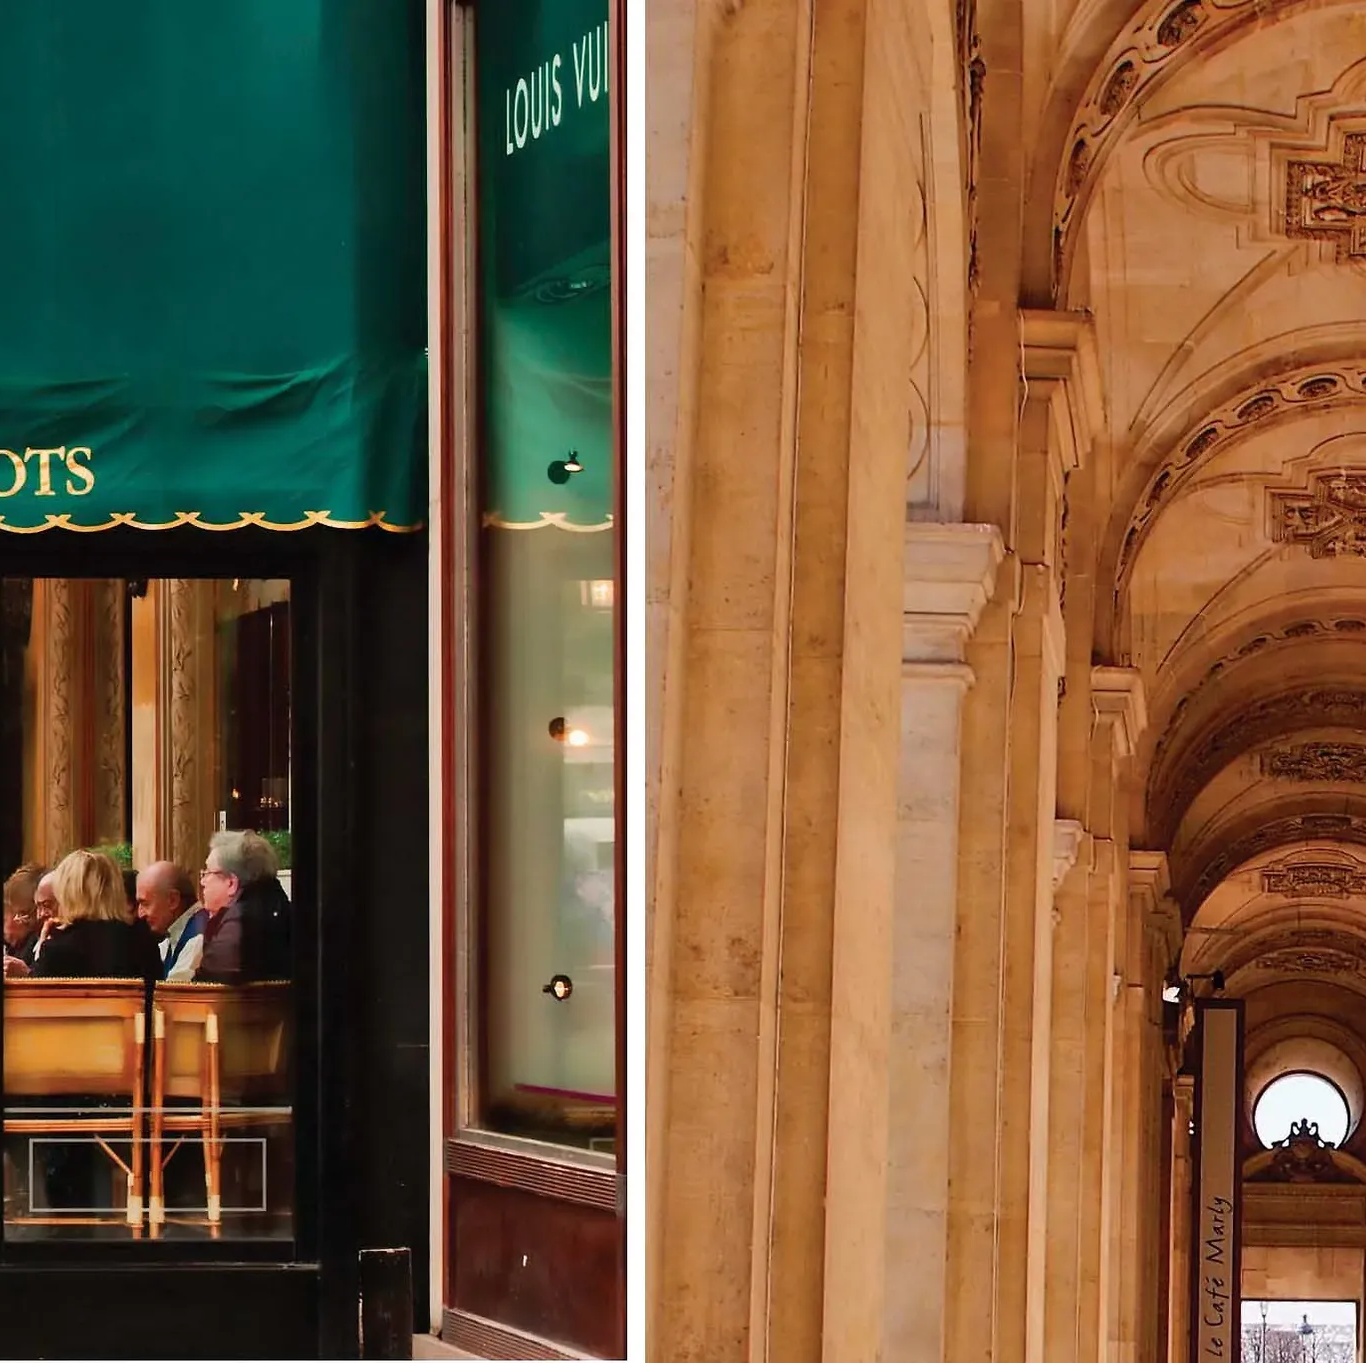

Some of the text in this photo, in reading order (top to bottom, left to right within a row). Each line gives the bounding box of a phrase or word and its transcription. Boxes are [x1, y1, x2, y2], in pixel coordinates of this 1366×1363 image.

[506, 53, 562, 156] LOUIS
[1205, 1196, 1233, 1265] Marly
[1204, 1276, 1230, 1327] Café
